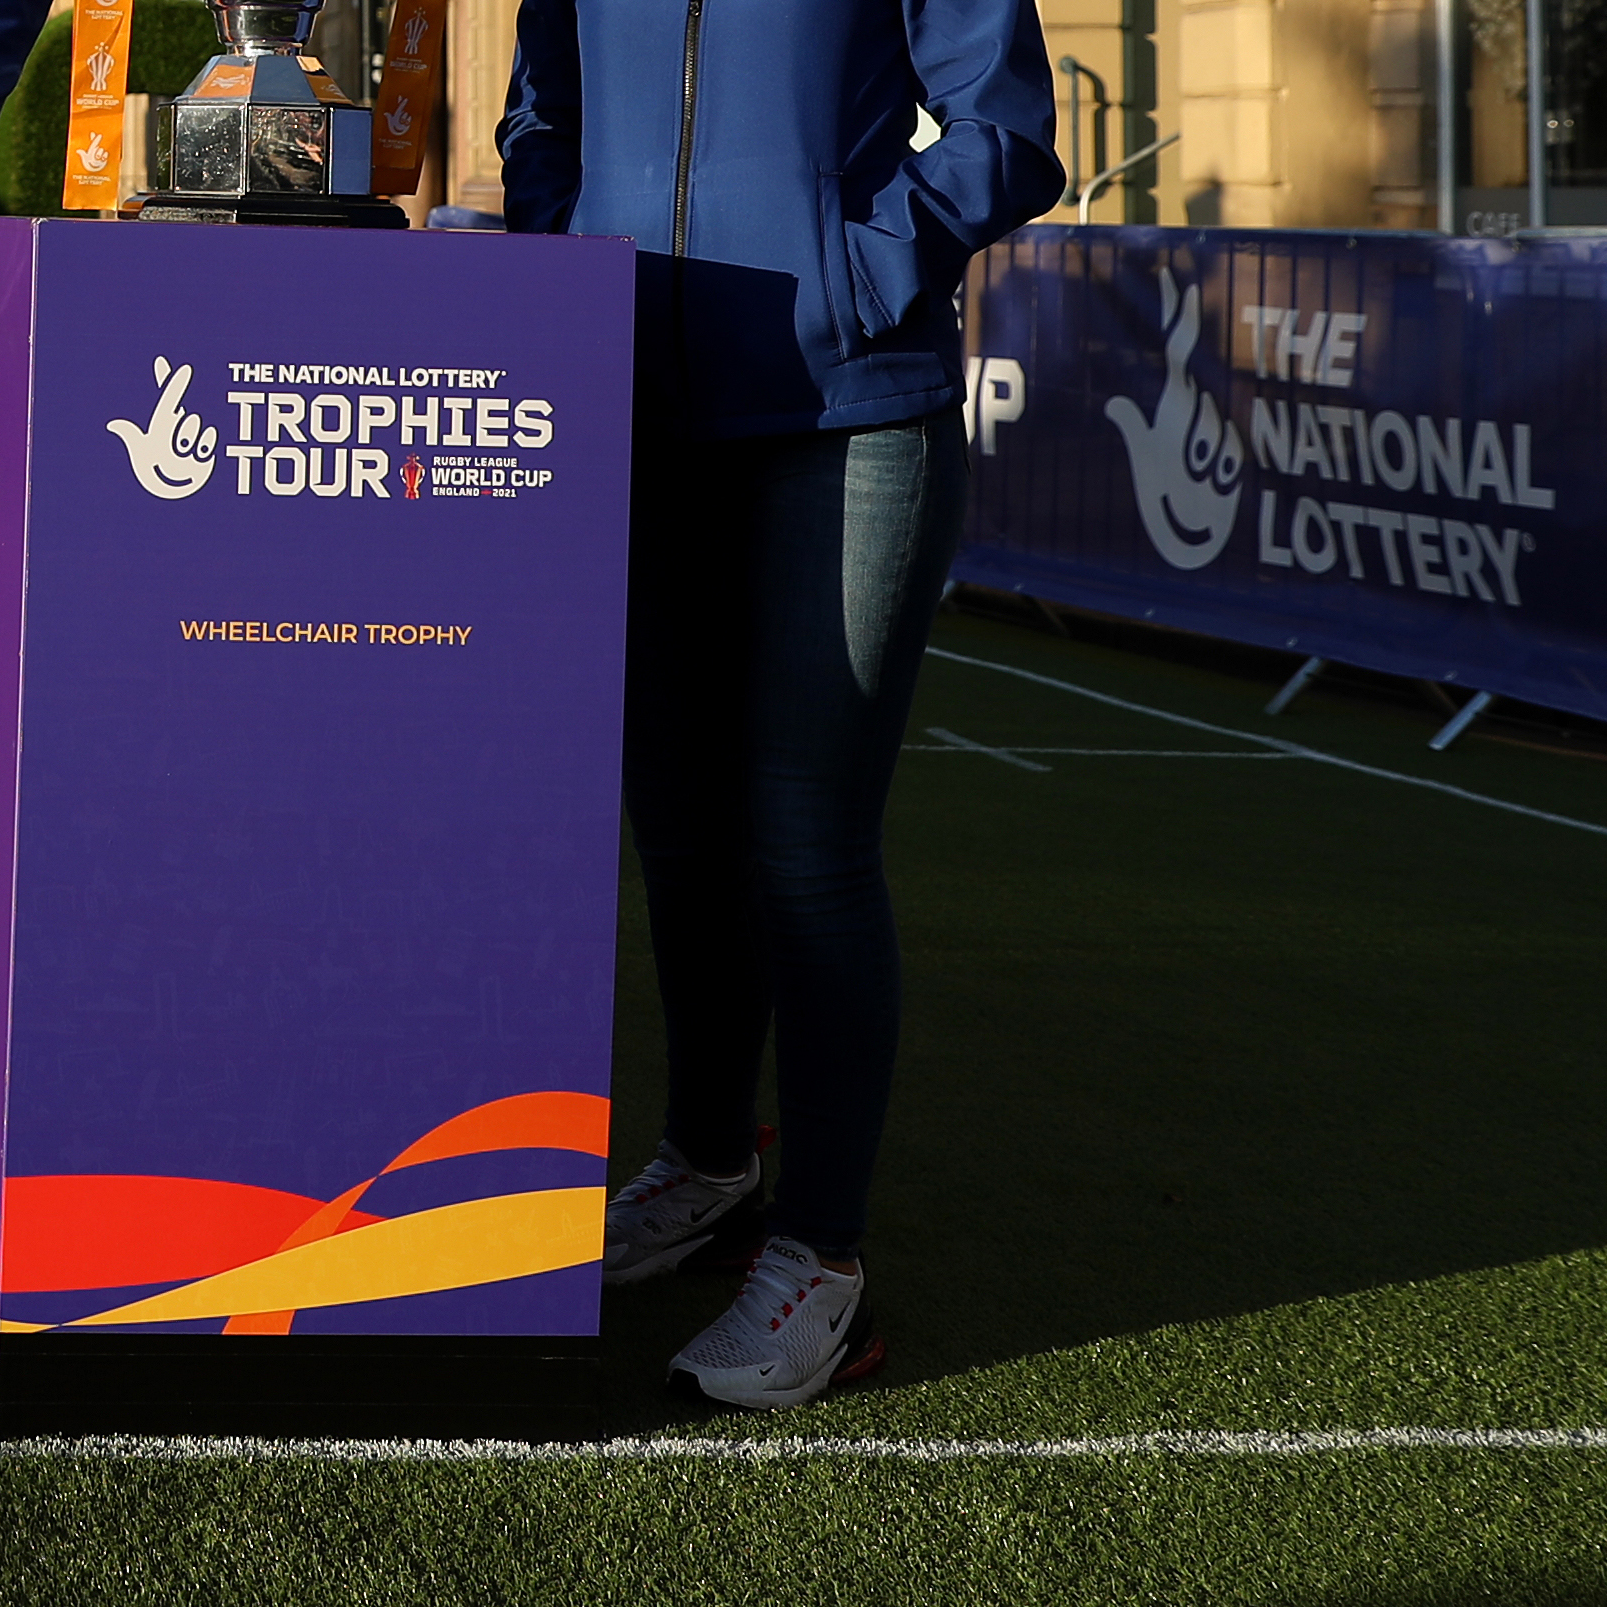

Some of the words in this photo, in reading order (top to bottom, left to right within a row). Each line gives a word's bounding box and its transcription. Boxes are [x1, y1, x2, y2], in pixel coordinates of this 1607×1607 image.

[1242, 304, 1369, 389] THE
[228, 363, 274, 384] THE
[278, 364, 395, 387] NATIONAL
[399, 367, 507, 390] LOTTERY
[226, 391, 555, 449] TROPHIES
[433, 455, 472, 467] RUGBY
[474, 457, 518, 468] LEAGUE
[1249, 396, 1558, 511] NATIONAL
[225, 445, 391, 499] TOUR
[431, 467, 505, 486] WORLD
[510, 470, 554, 488] CUP
[432, 486, 481, 497] ENGLAND
[491, 488, 518, 498] 2021
[179, 620, 358, 644] WHEELCHAIR
[364, 624, 473, 647] TROPHY
